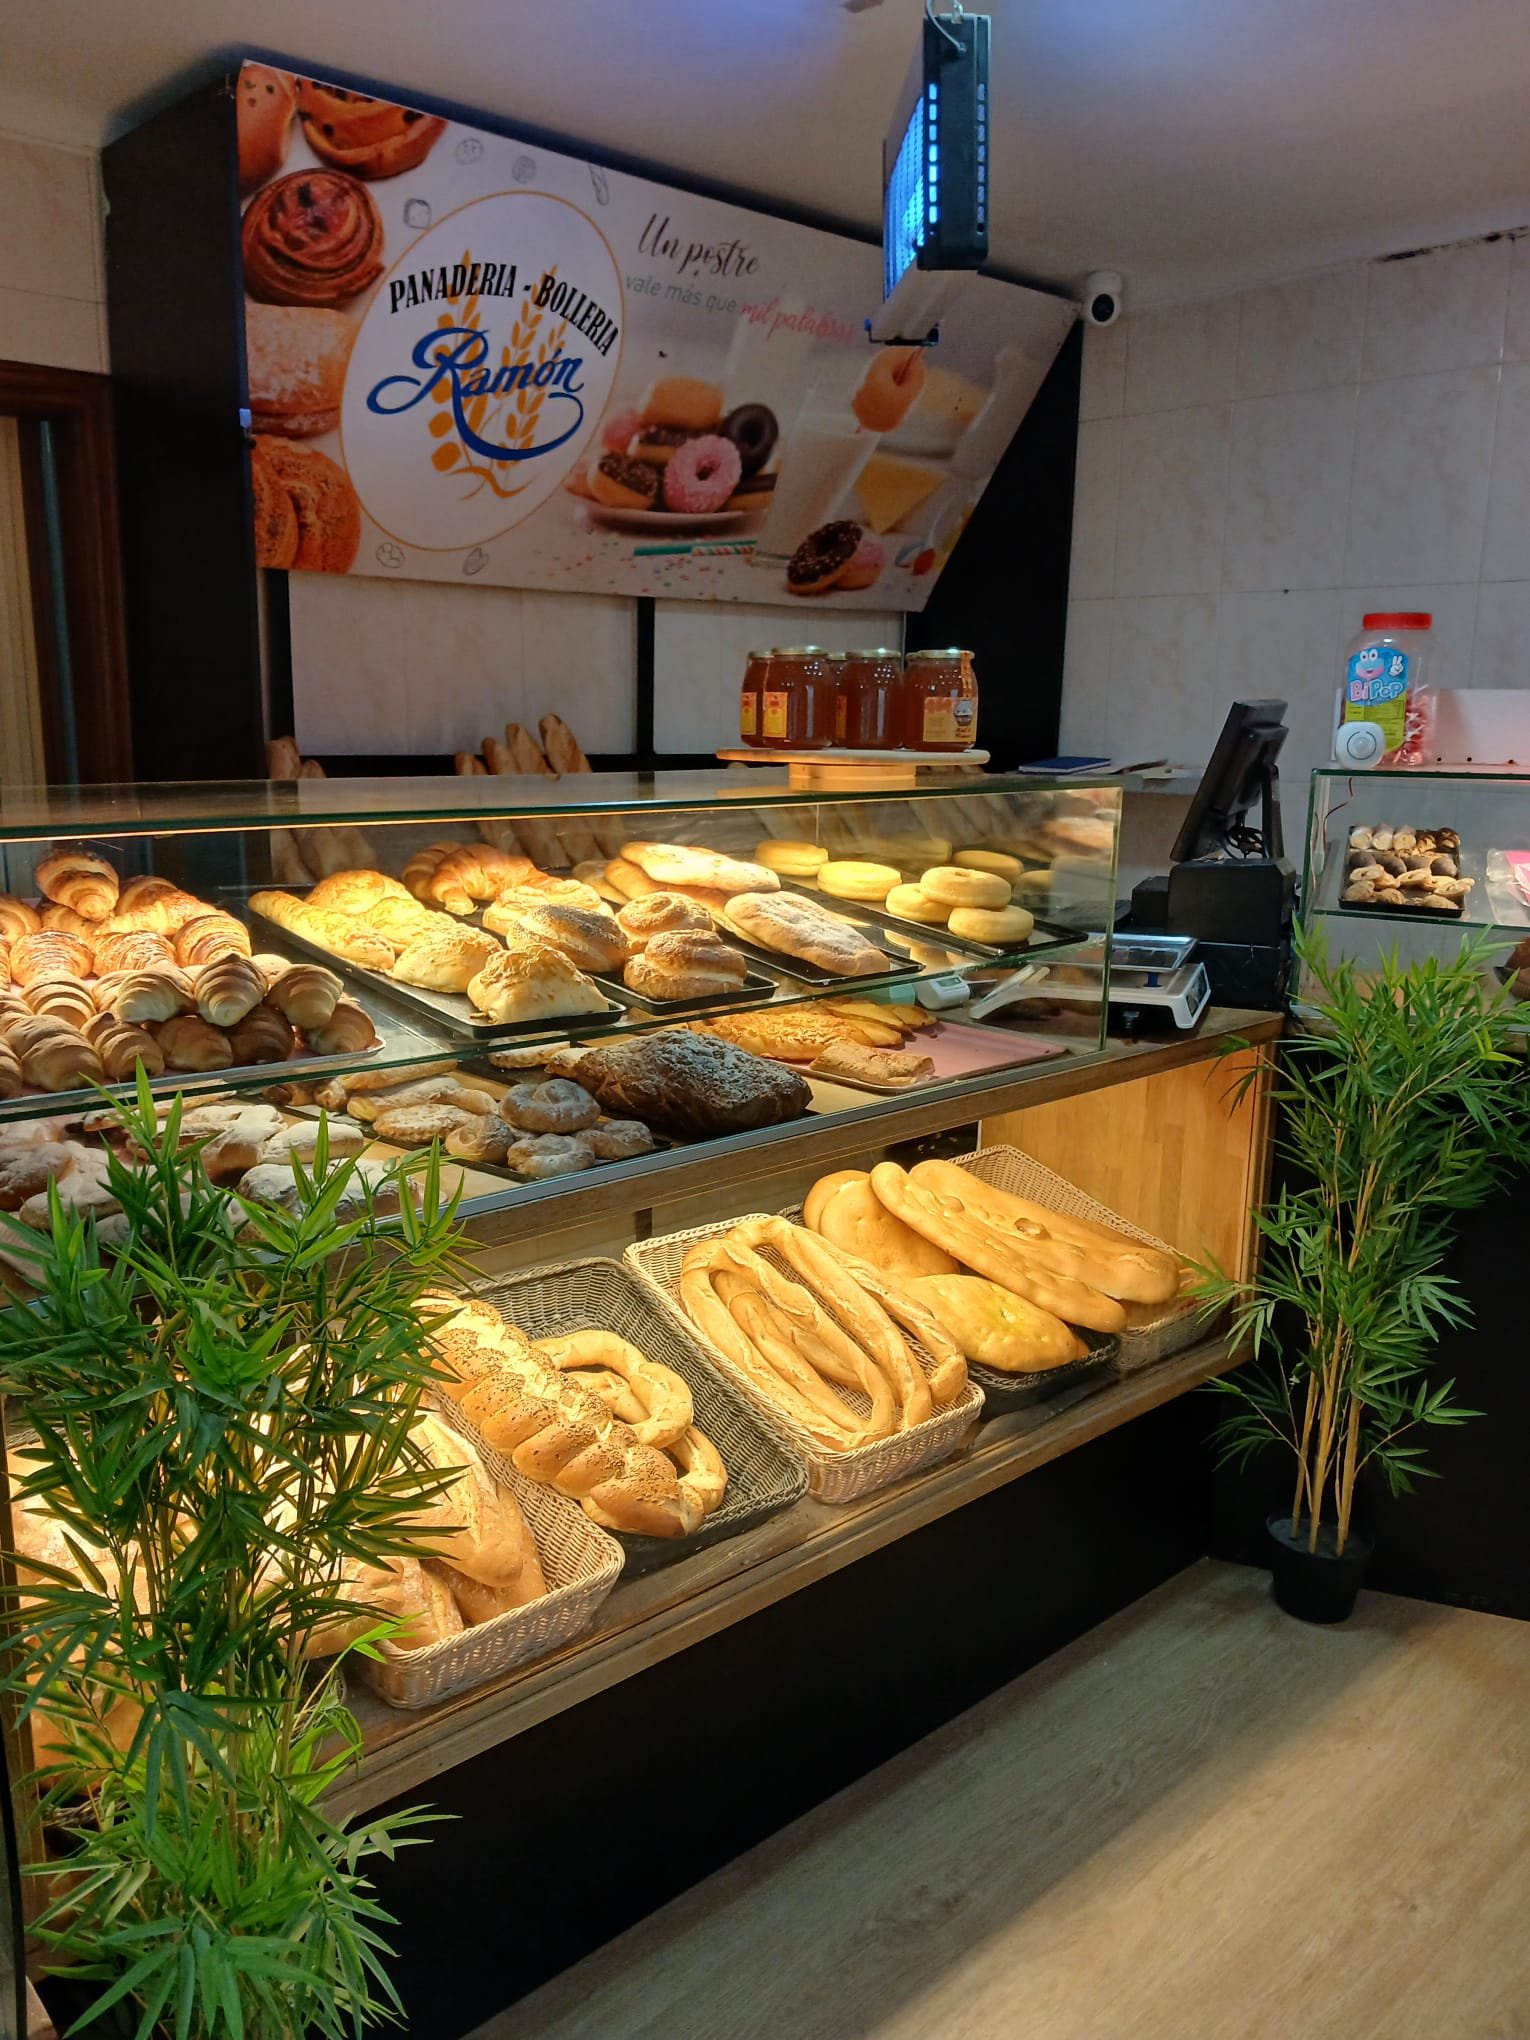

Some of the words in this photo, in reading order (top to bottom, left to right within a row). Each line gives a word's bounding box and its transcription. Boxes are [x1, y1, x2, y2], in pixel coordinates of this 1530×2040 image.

[637, 212, 679, 259] Un
[675, 238, 760, 278] postre
[389, 262, 518, 315] PANADERIA
[533, 273, 620, 358] BOLLERIA
[625, 272, 662, 297] vale
[664, 281, 700, 307] más
[705, 294, 738, 314] que
[740, 298, 779, 325] mil
[365, 326, 585, 462] Ramón
